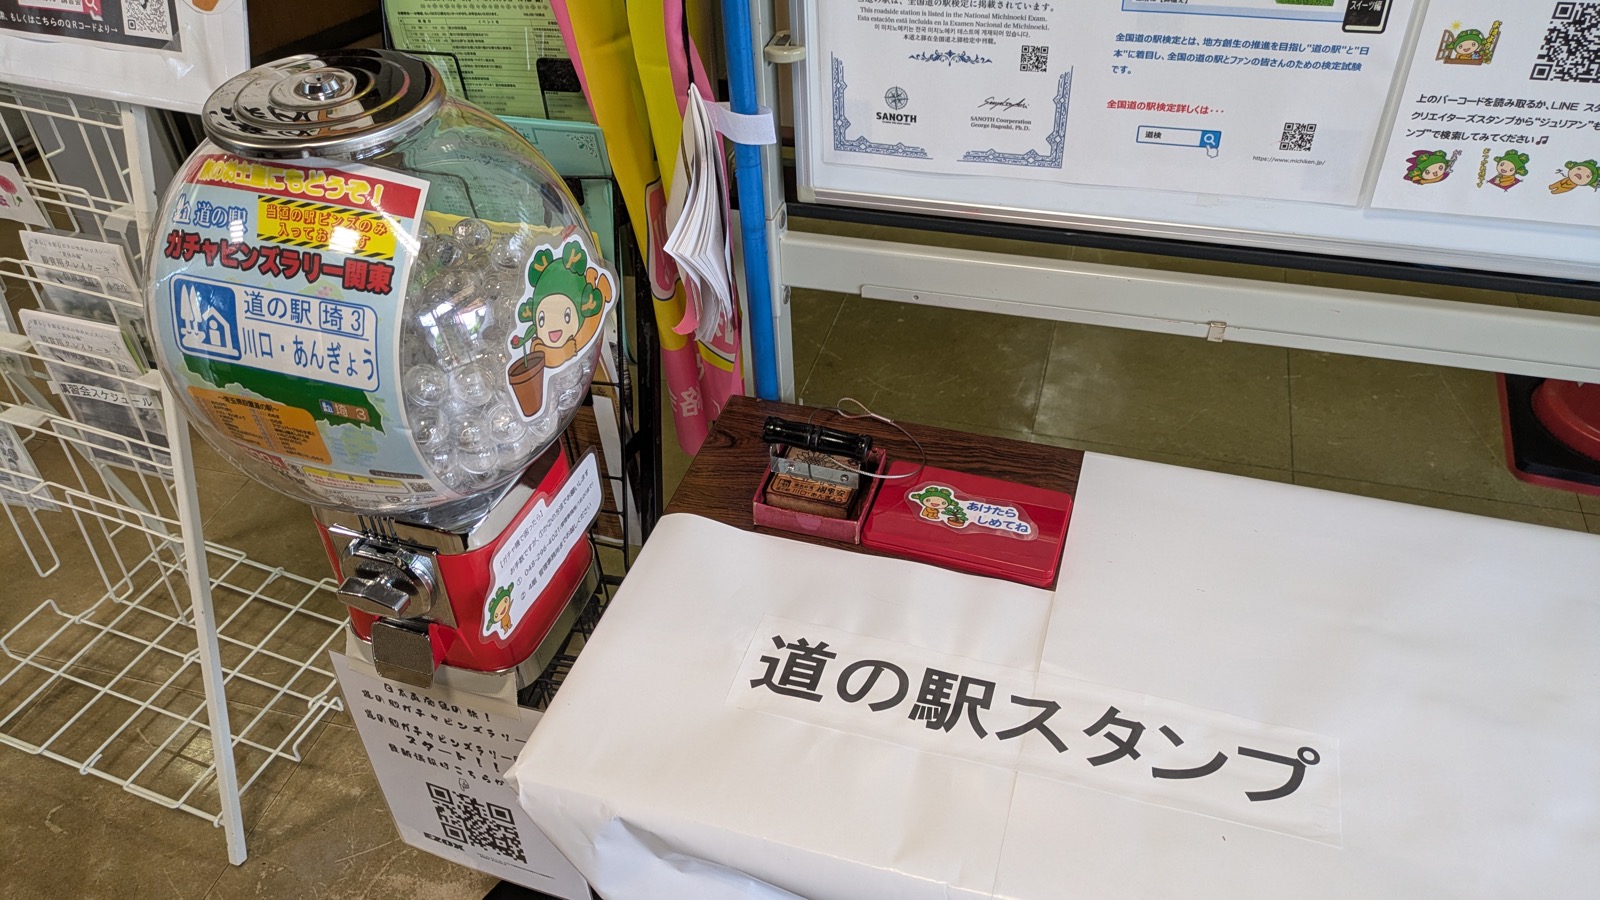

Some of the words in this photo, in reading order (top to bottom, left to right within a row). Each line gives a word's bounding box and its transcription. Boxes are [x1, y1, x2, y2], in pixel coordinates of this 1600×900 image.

[874, 7, 899, 15] roadside
[1111, 65, 1131, 75] です。
[876, 111, 917, 124] SANOTH
[970, 115, 995, 123] SANOTH
[970, 122, 990, 130] George
[1015, 124, 1031, 132] Ph.D.
[1145, 130, 1162, 140] 道検
[195, 200, 248, 234] 道の駅
[266, 204, 388, 237] 当道の駅ピンズのみ
[278, 222, 371, 250] 入っておす
[164, 229, 395, 296] ガチャピンズラリー関東
[243, 290, 312, 326] 道の駅
[322, 304, 344, 332] 埼
[350, 309, 362, 332] 3
[242, 327, 375, 382] 川口・あんぎょう
[60, 382, 153, 407] 講習会スケジュール
[355, 408, 367, 420] 3
[966, 502, 1017, 518] あけたら
[977, 515, 1029, 533] しめてね
[750, 635, 1321, 802] 道の駅スタンプ
[364, 709, 518, 762] 道の駅ガチャピンズラリー
[423, 831, 466, 852] EZOX
